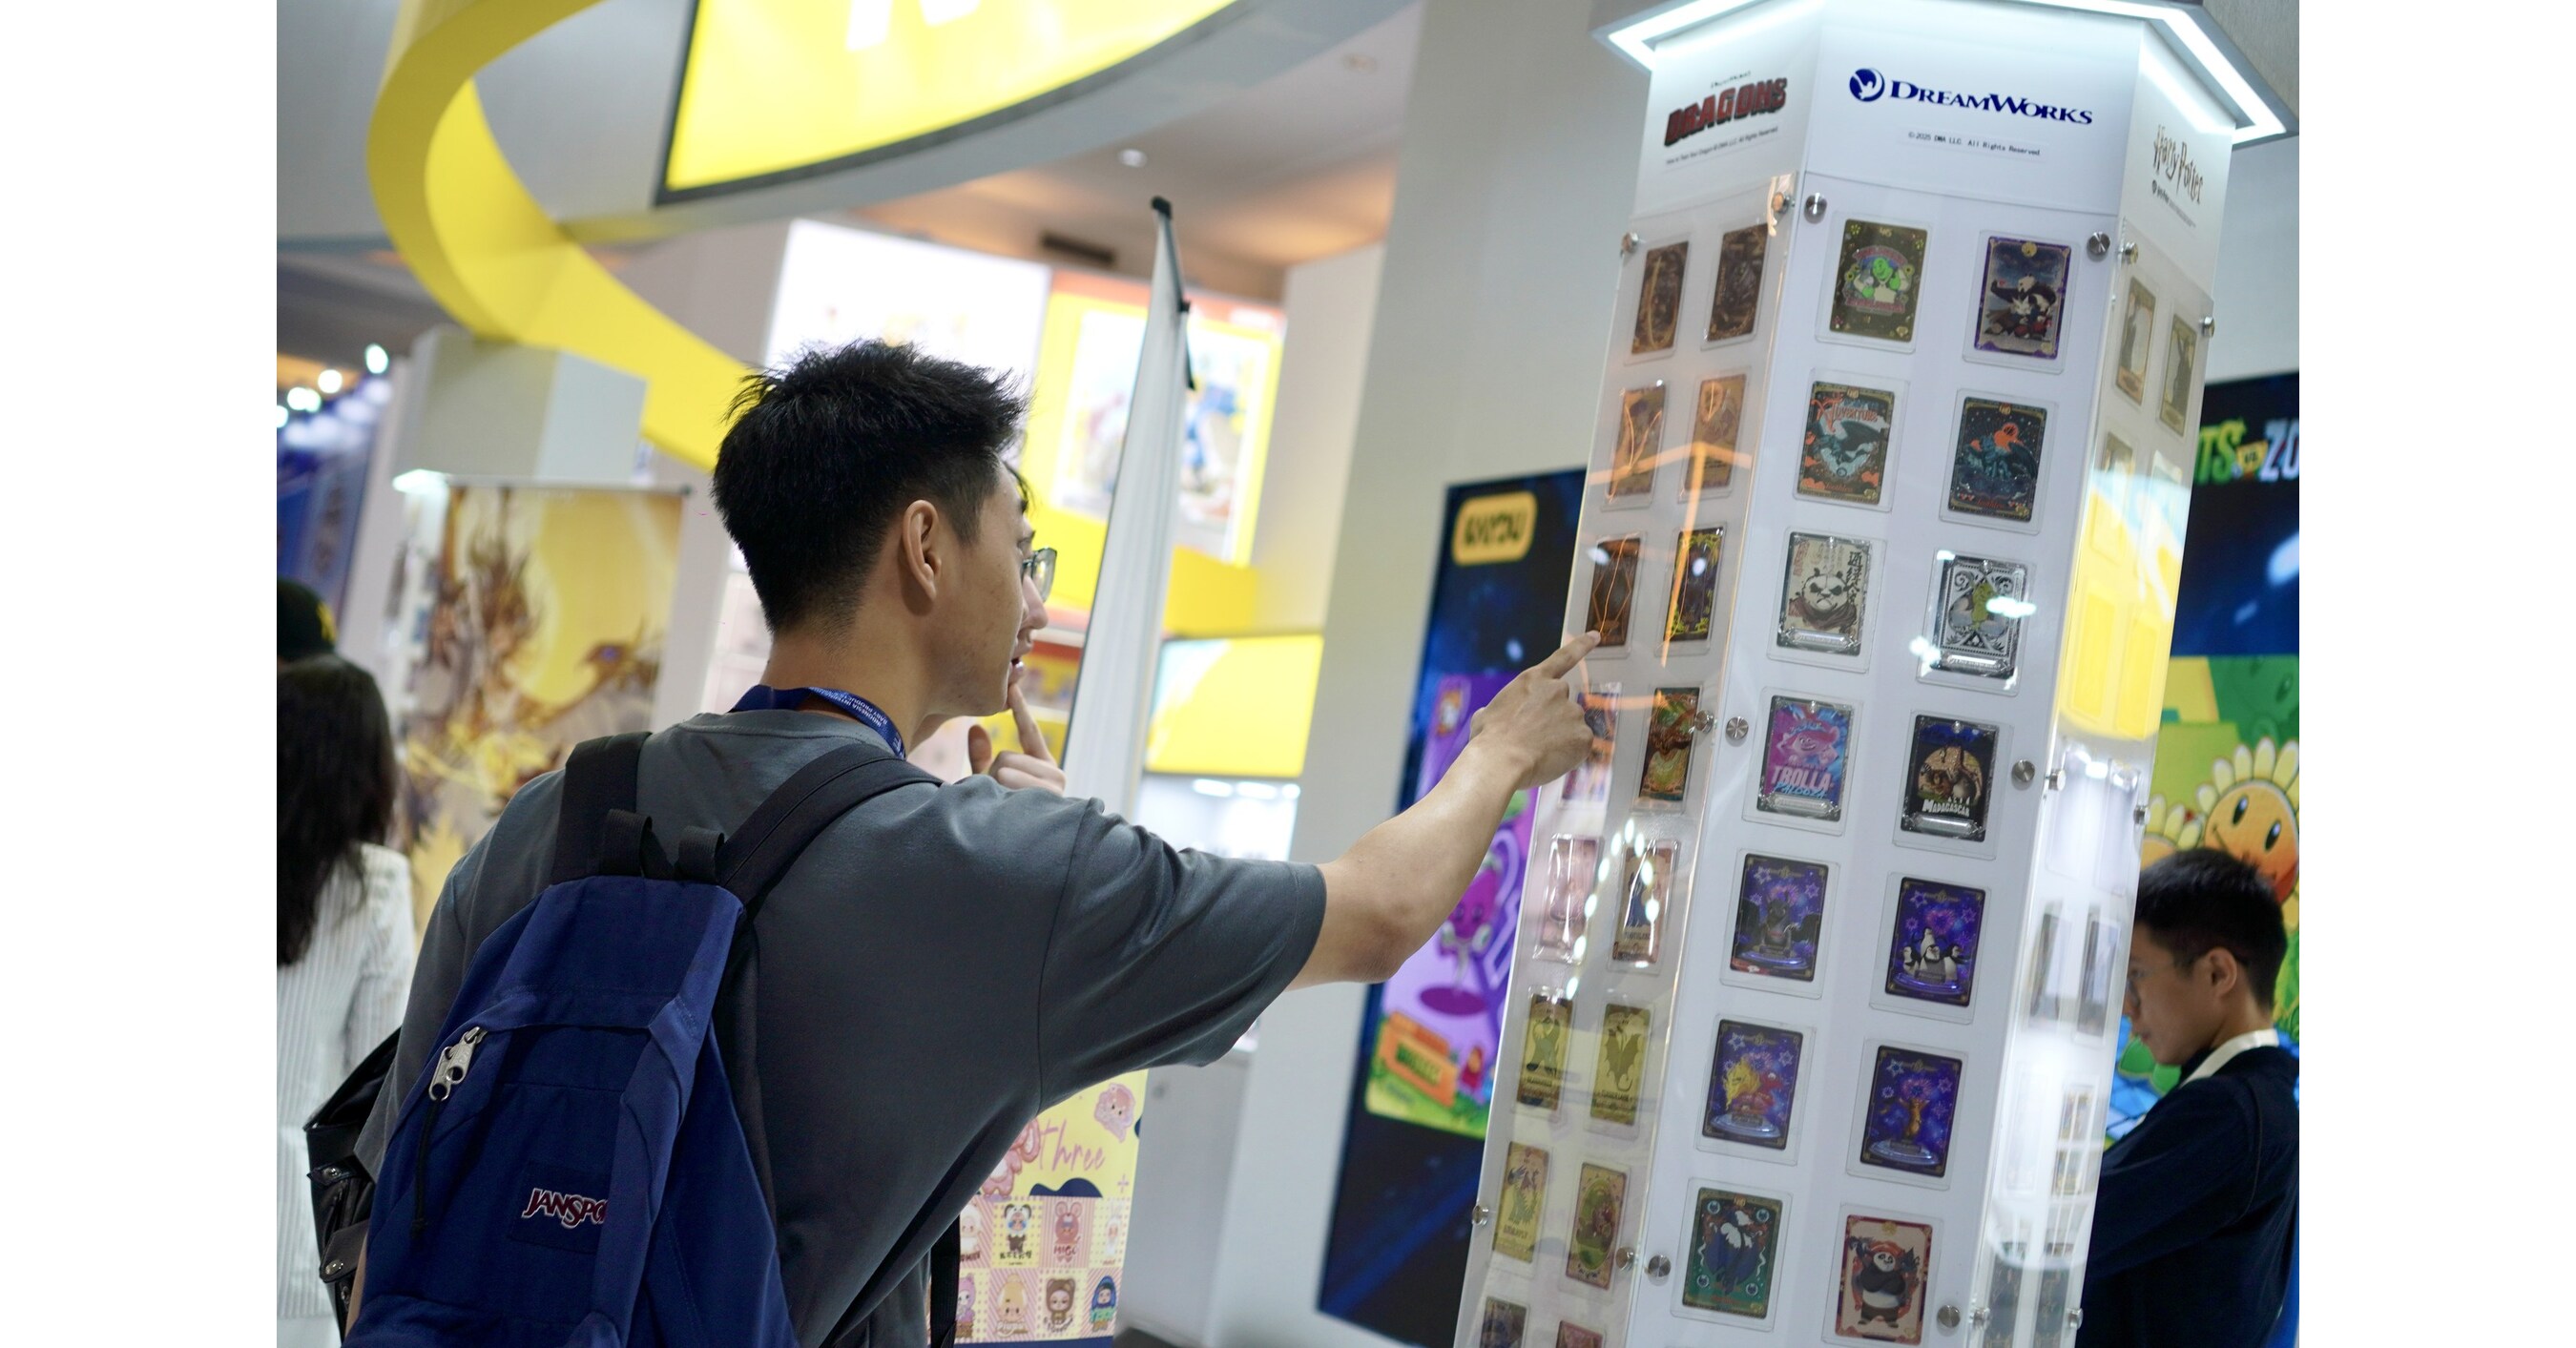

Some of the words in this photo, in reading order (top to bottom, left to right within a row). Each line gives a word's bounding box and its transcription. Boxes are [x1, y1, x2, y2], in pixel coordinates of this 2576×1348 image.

[1664, 77, 1788, 147] DRAGONS
[1967, 139, 1980, 148] All
[1983, 142, 2005, 154] Rights
[852, 701, 883, 727] INDONESIA
[522, 1188, 609, 1228] JANSPO
